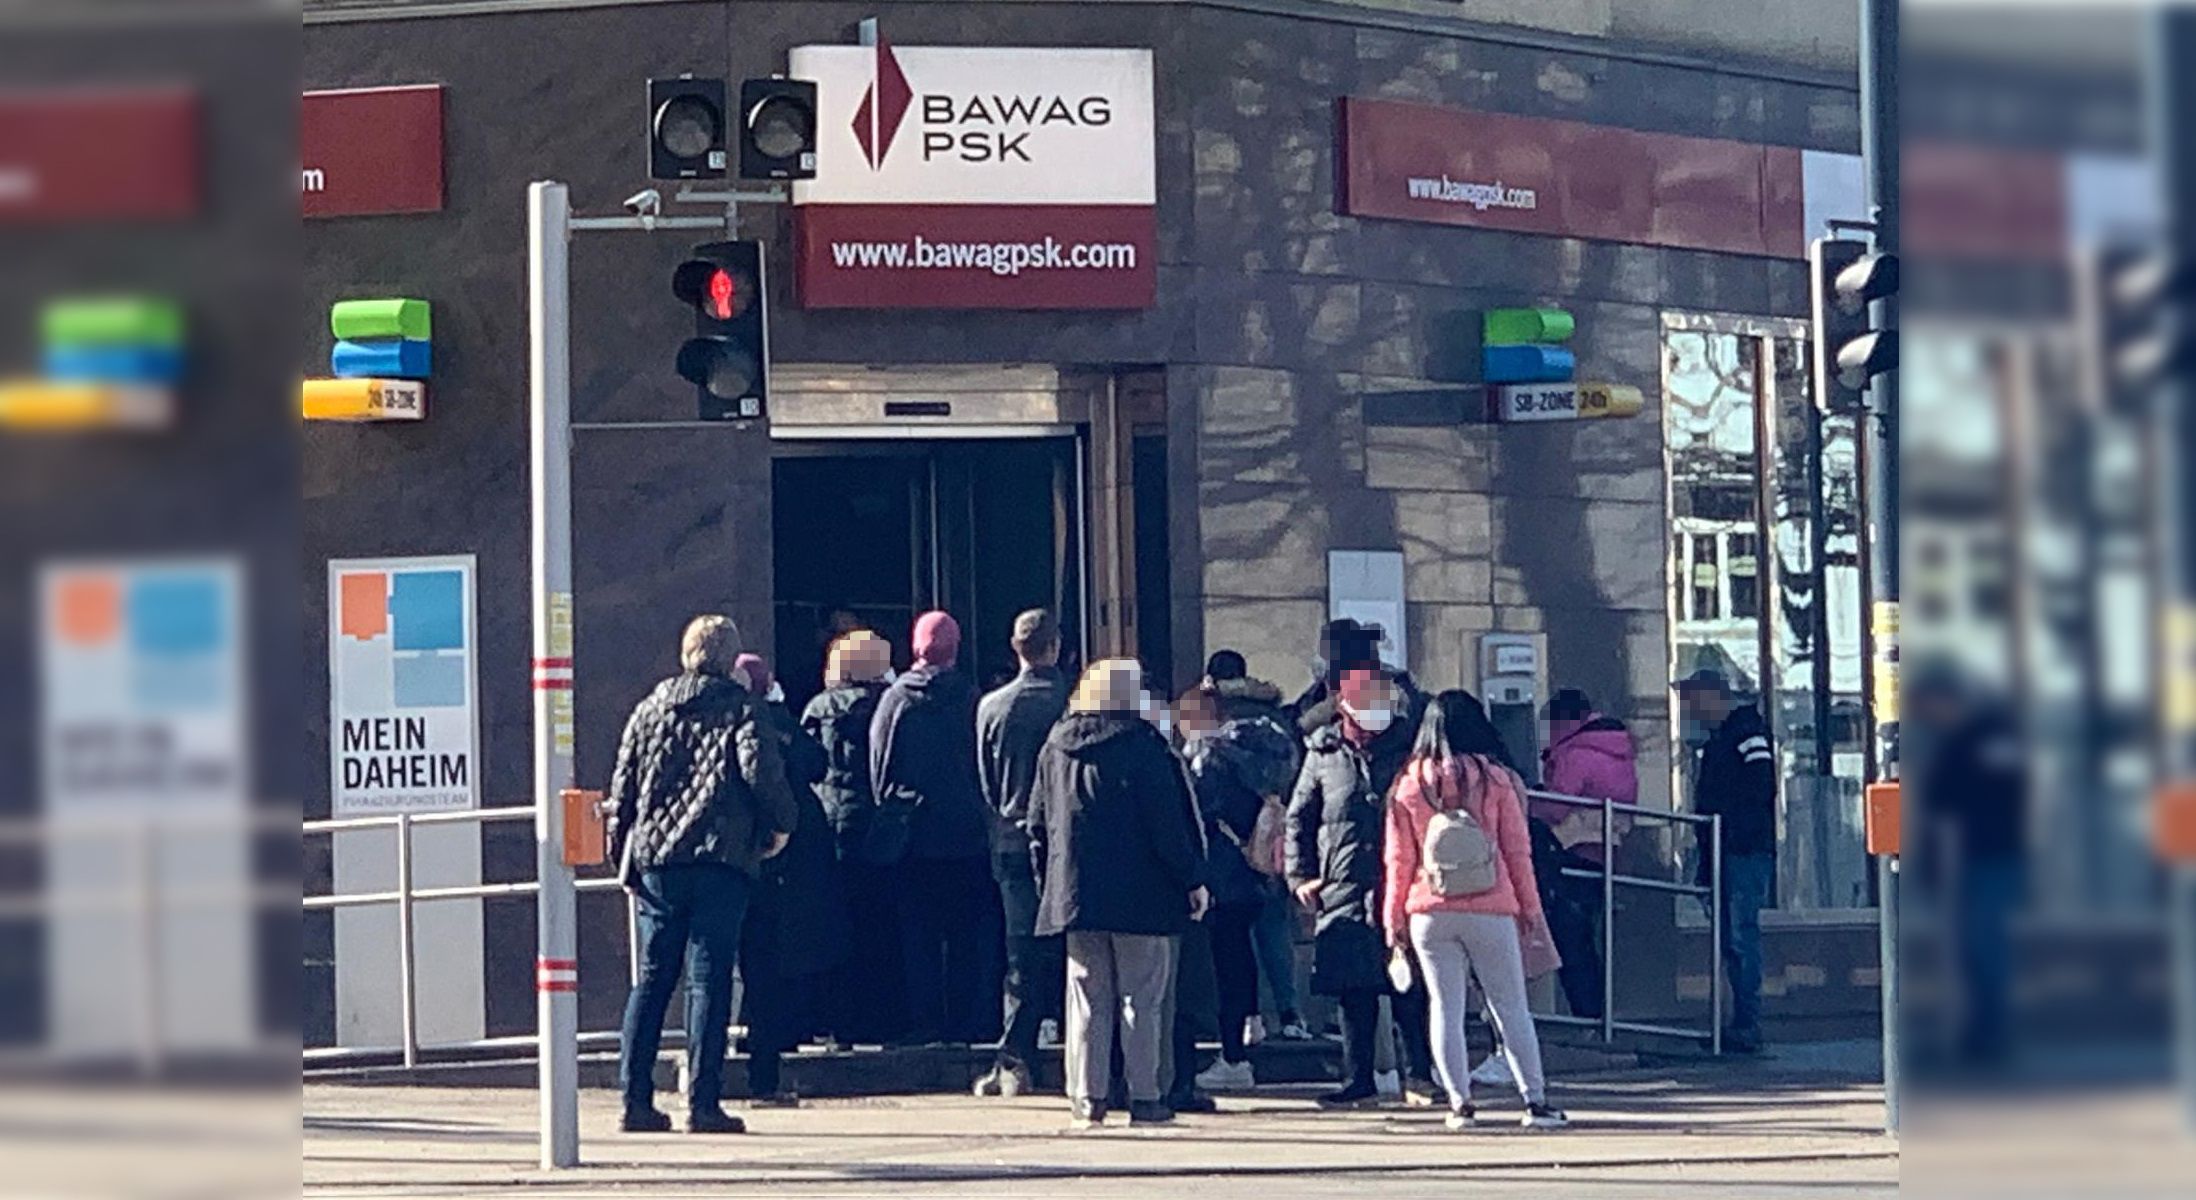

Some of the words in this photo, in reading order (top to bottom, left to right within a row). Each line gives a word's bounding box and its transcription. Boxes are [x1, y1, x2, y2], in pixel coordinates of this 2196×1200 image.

[922, 95, 1111, 125] BAWAG
[922, 132, 1032, 161] PSK
[1408, 174, 1536, 210] www.bawagpsk.com
[832, 236, 1136, 275] www.bawagpsk.com
[1515, 391, 1575, 412] SB-ZONE
[343, 717, 425, 752] MEIN
[344, 754, 467, 789] DAHEIM
